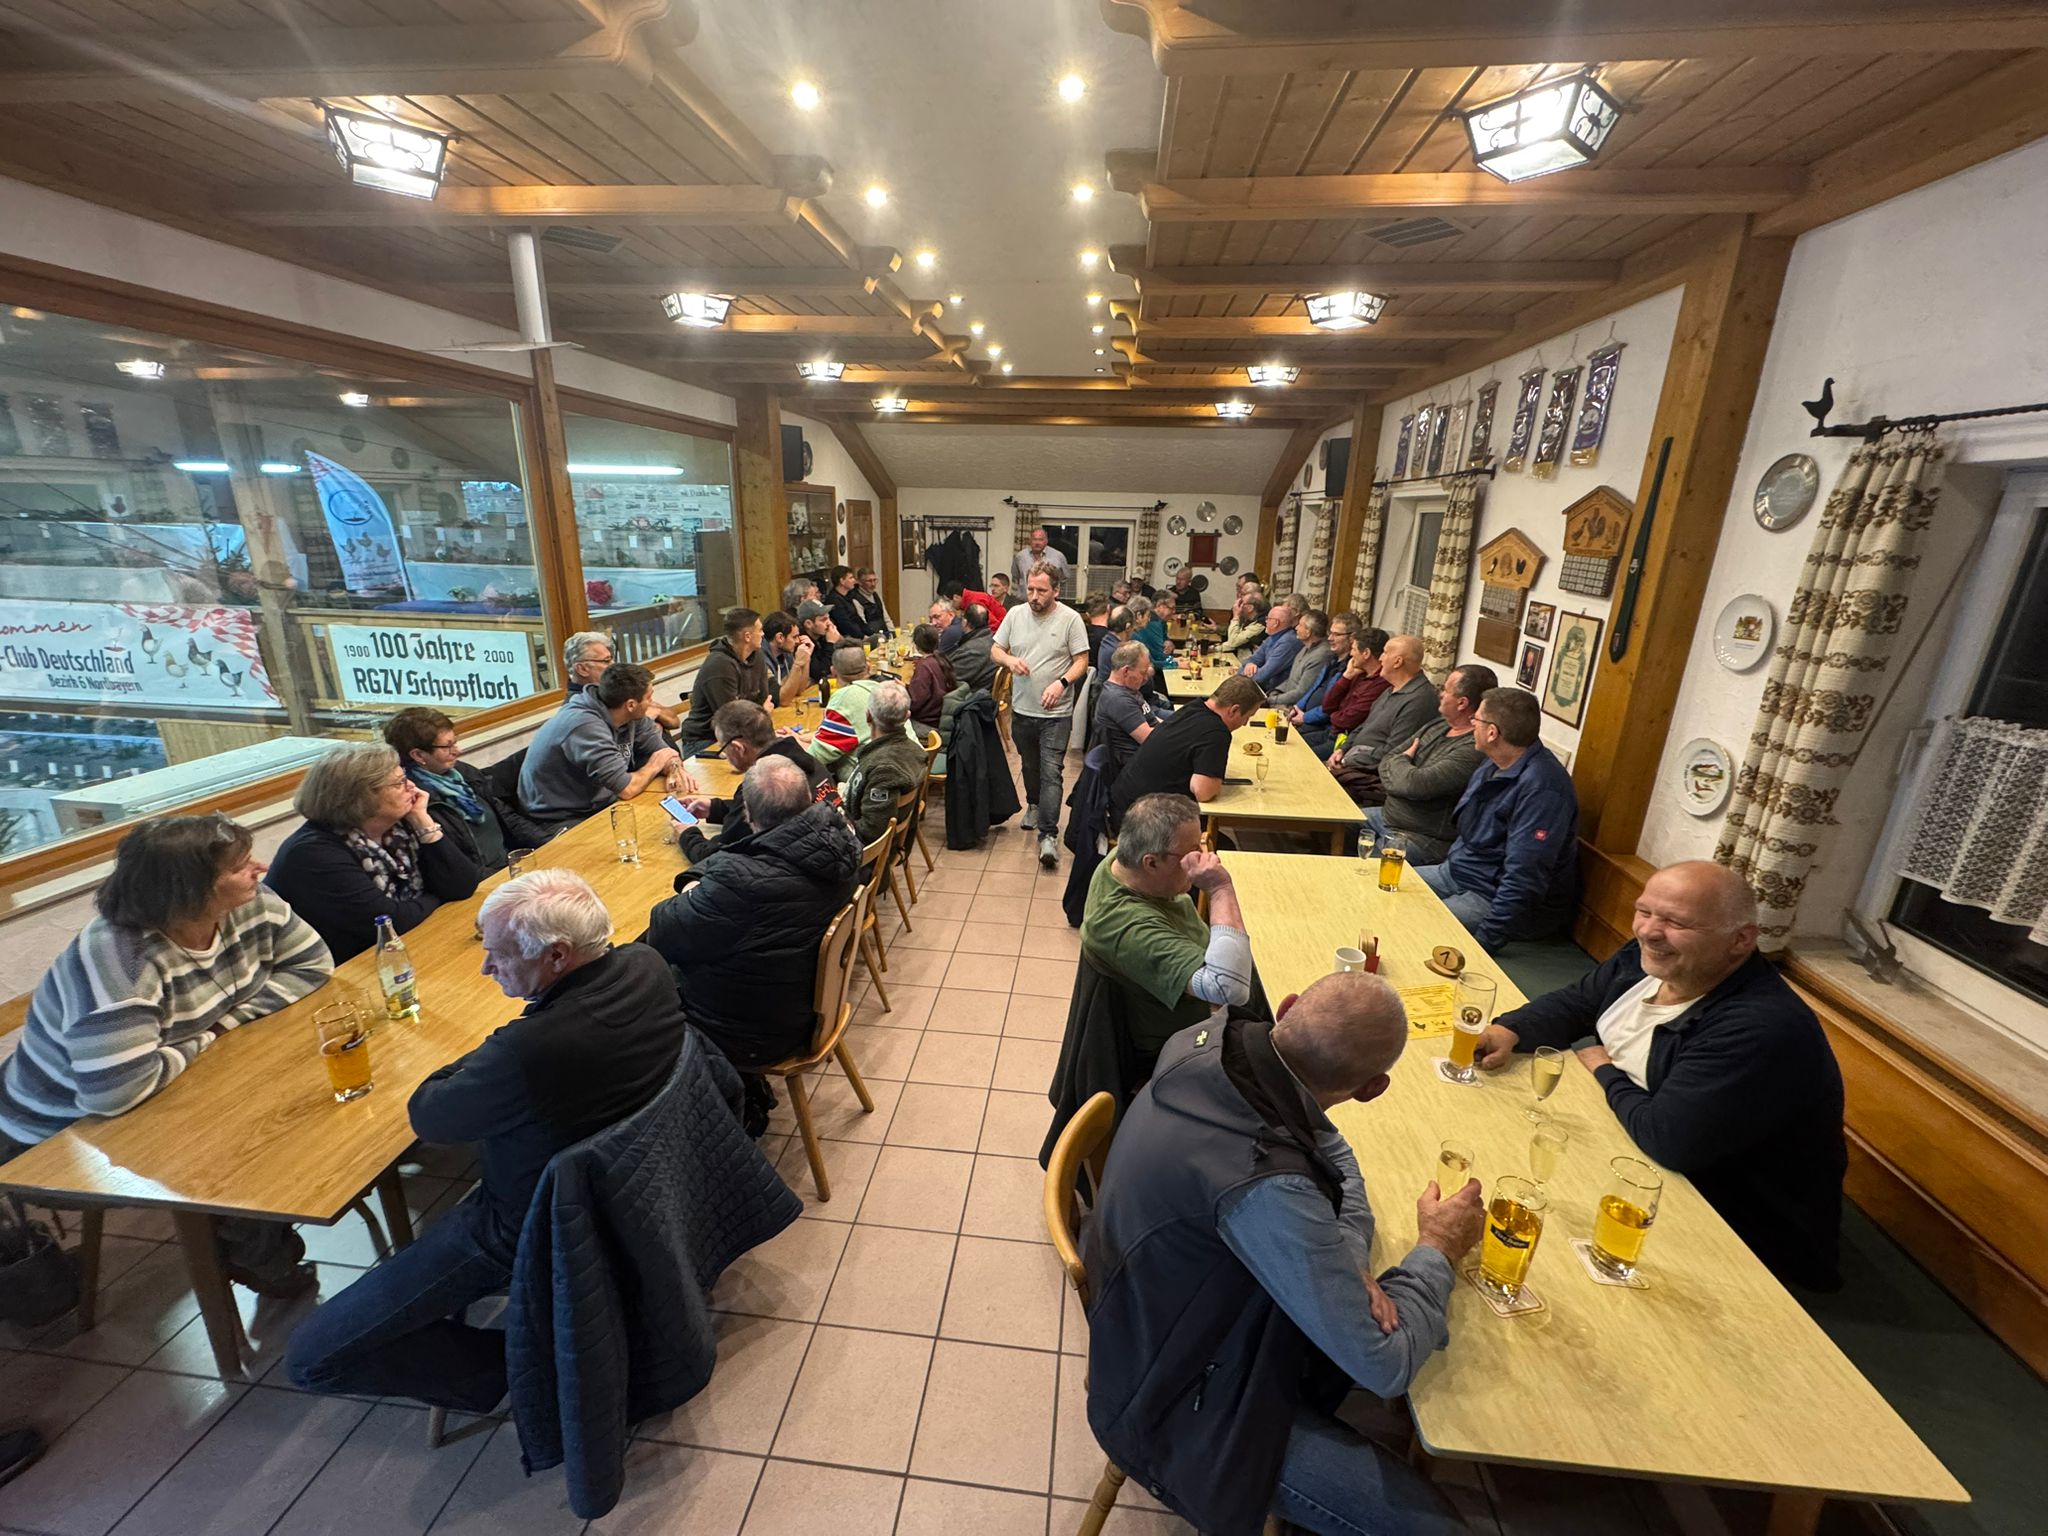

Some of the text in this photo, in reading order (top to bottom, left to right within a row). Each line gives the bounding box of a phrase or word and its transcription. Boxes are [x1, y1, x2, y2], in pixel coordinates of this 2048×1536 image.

[0, 621, 92, 635] ommen
[0, 644, 135, 674] -Club Deutschland
[344, 631, 514, 664] 1900 100 Jahre 2000
[48, 674, 144, 694] Bezirk 6 Nordbayern
[353, 667, 520, 702] RGZV Schopfloch
